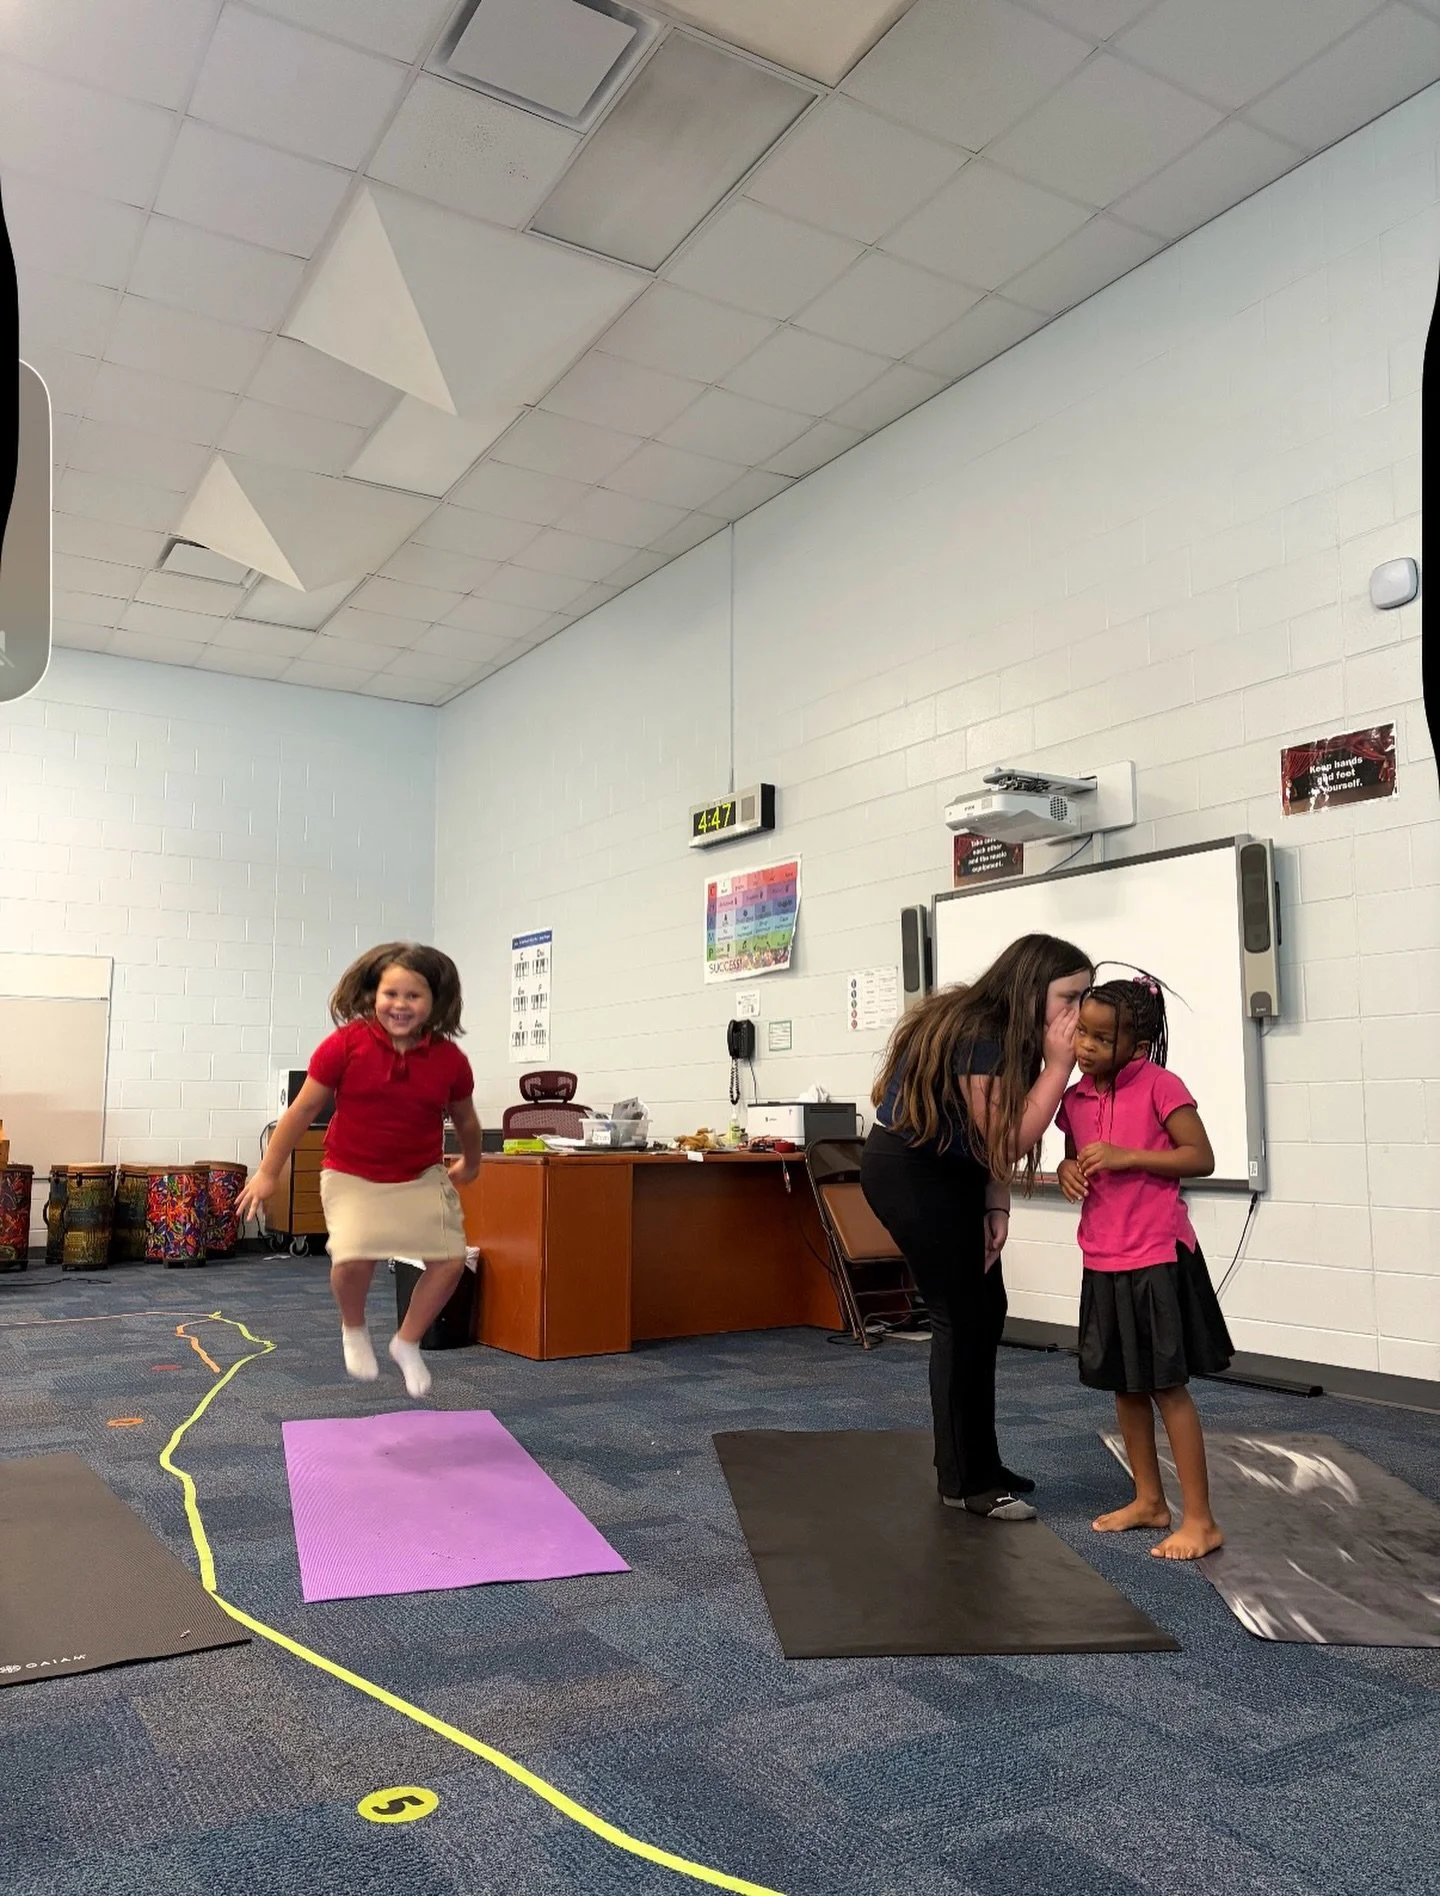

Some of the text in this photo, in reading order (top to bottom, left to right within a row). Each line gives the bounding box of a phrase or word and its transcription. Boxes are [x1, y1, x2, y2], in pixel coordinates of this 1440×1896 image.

[1310, 757, 1363, 774] Keep hands
[1336, 769, 1356, 779] feet
[698, 803, 731, 833] 4:47
[709, 959, 743, 974] SUCCESS!
[372, 1795, 424, 1815] 5
